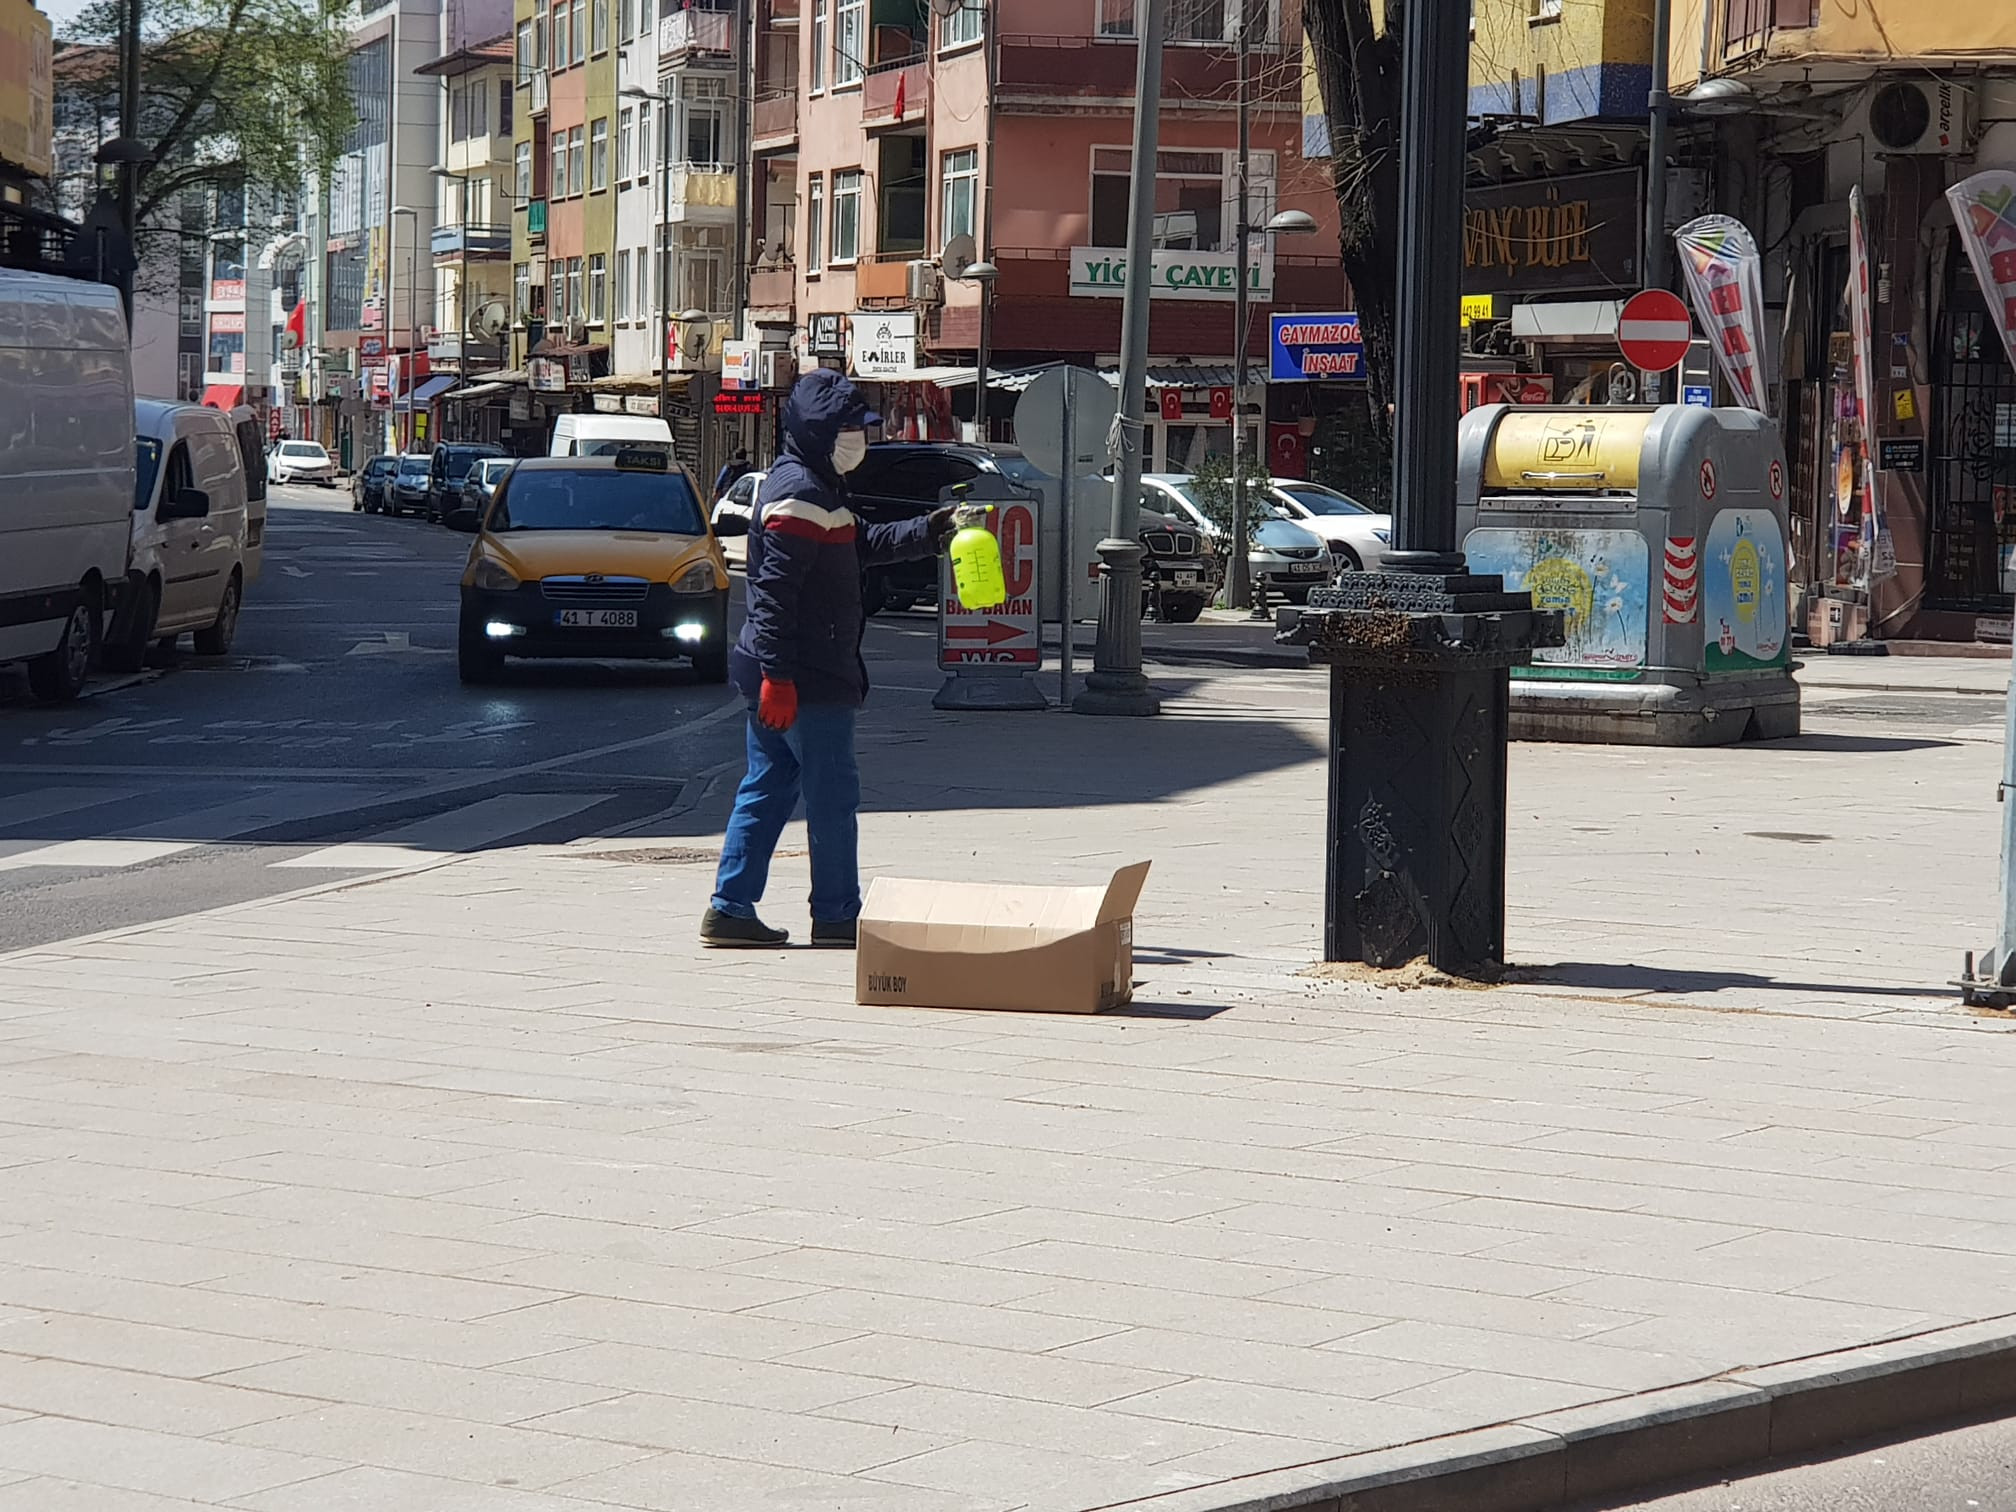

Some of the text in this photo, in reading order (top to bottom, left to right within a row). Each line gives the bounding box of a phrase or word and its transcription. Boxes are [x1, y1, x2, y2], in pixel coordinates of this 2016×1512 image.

[1939, 82, 1953, 132] arçelik
[1525, 186, 1589, 267] BÜFE
[1085, 257, 1158, 283] YİĞ
[1303, 348, 1357, 378] İNŞAAT
[562, 611, 635, 625] 41 T 4088
[868, 971, 907, 992] BÜYÜK BOY
